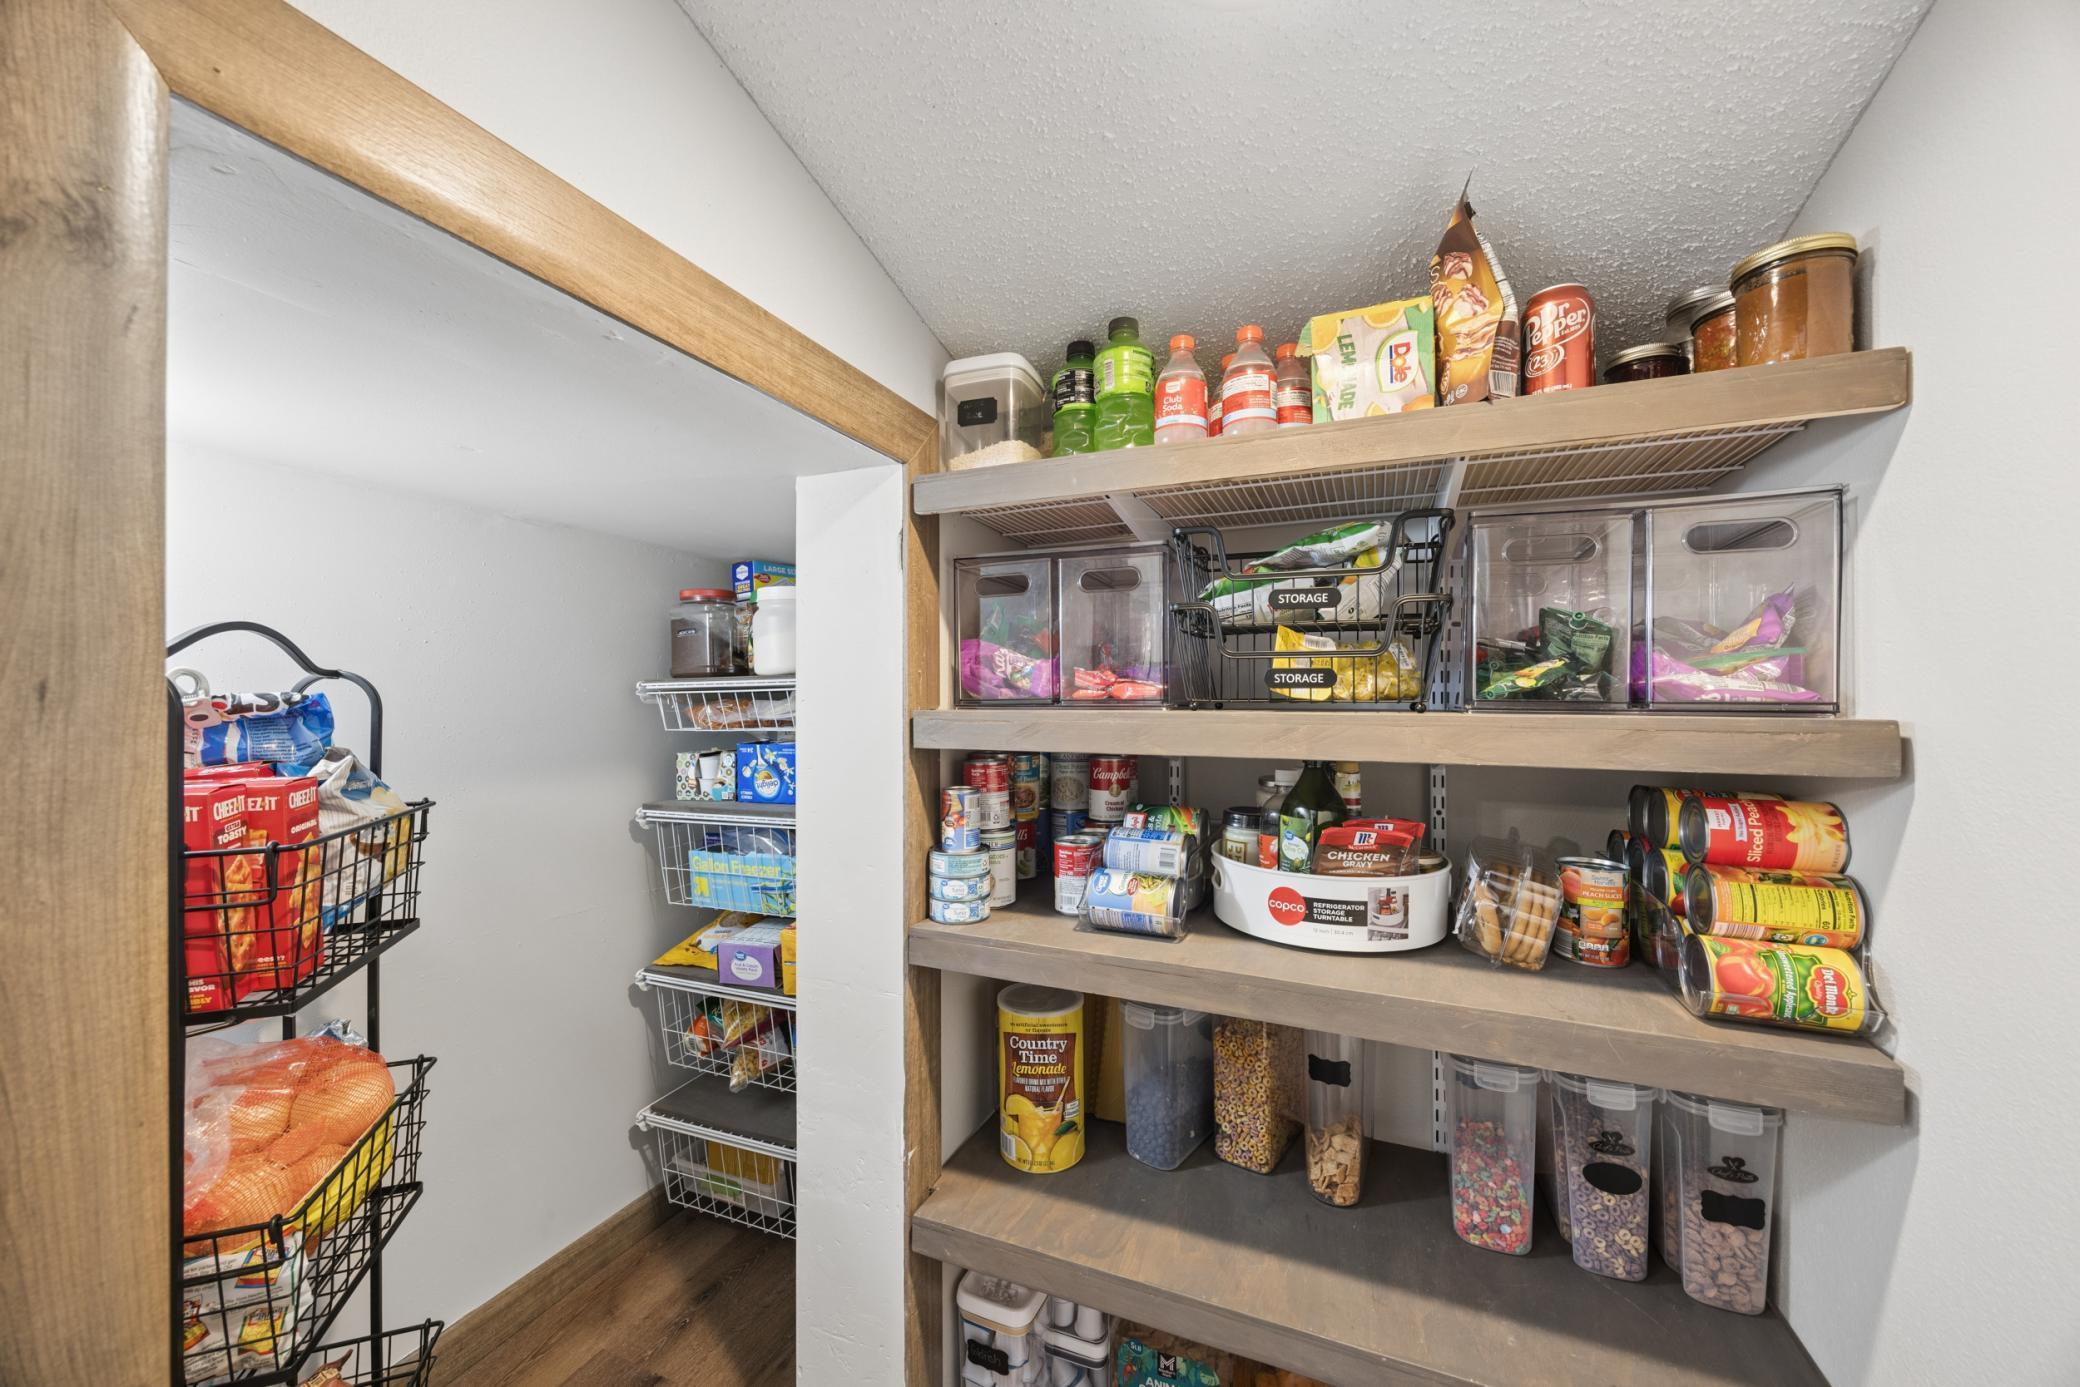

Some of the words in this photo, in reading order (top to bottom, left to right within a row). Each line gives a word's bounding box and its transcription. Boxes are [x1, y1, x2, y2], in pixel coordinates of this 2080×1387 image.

[1540, 302, 1570, 321] Dr
[1525, 309, 1587, 353] Pepper
[1391, 342, 1411, 382] Dole
[1533, 354, 1548, 370] 23
[1337, 333, 1357, 411] LEMADE
[1163, 395, 1182, 404] Club
[1162, 403, 1183, 412] Soda
[763, 565, 785, 574] LARGE
[1278, 593, 1329, 604] STORAGE
[1274, 673, 1325, 684] STORAGE
[291, 819, 317, 834] ORIGINAL
[218, 826, 247, 845] TOASTY
[1746, 829, 1763, 863] Sliced
[1327, 850, 1390, 862] CHICKEN
[731, 860, 780, 877] Freezer
[1343, 861, 1373, 869] GRAVY
[1582, 890, 1604, 899] PEACH
[1817, 889, 1827, 911] Calories
[1268, 899, 1305, 913] copco
[1313, 902, 1365, 911] REFRIGERATOR
[1844, 891, 1855, 915] Nutrition
[1313, 908, 1345, 916] STORAGE
[1313, 914, 1353, 922] TURNTABLE
[1821, 920, 1830, 930] 60
[1847, 915, 1856, 930] Facts
[1821, 968, 1834, 985] Del
[1009, 1036, 1068, 1053] Country
[1018, 1050, 1057, 1063] Time
[1012, 1061, 1067, 1077] Lemonade
[1024, 1085, 1040, 1093] NATURAL
